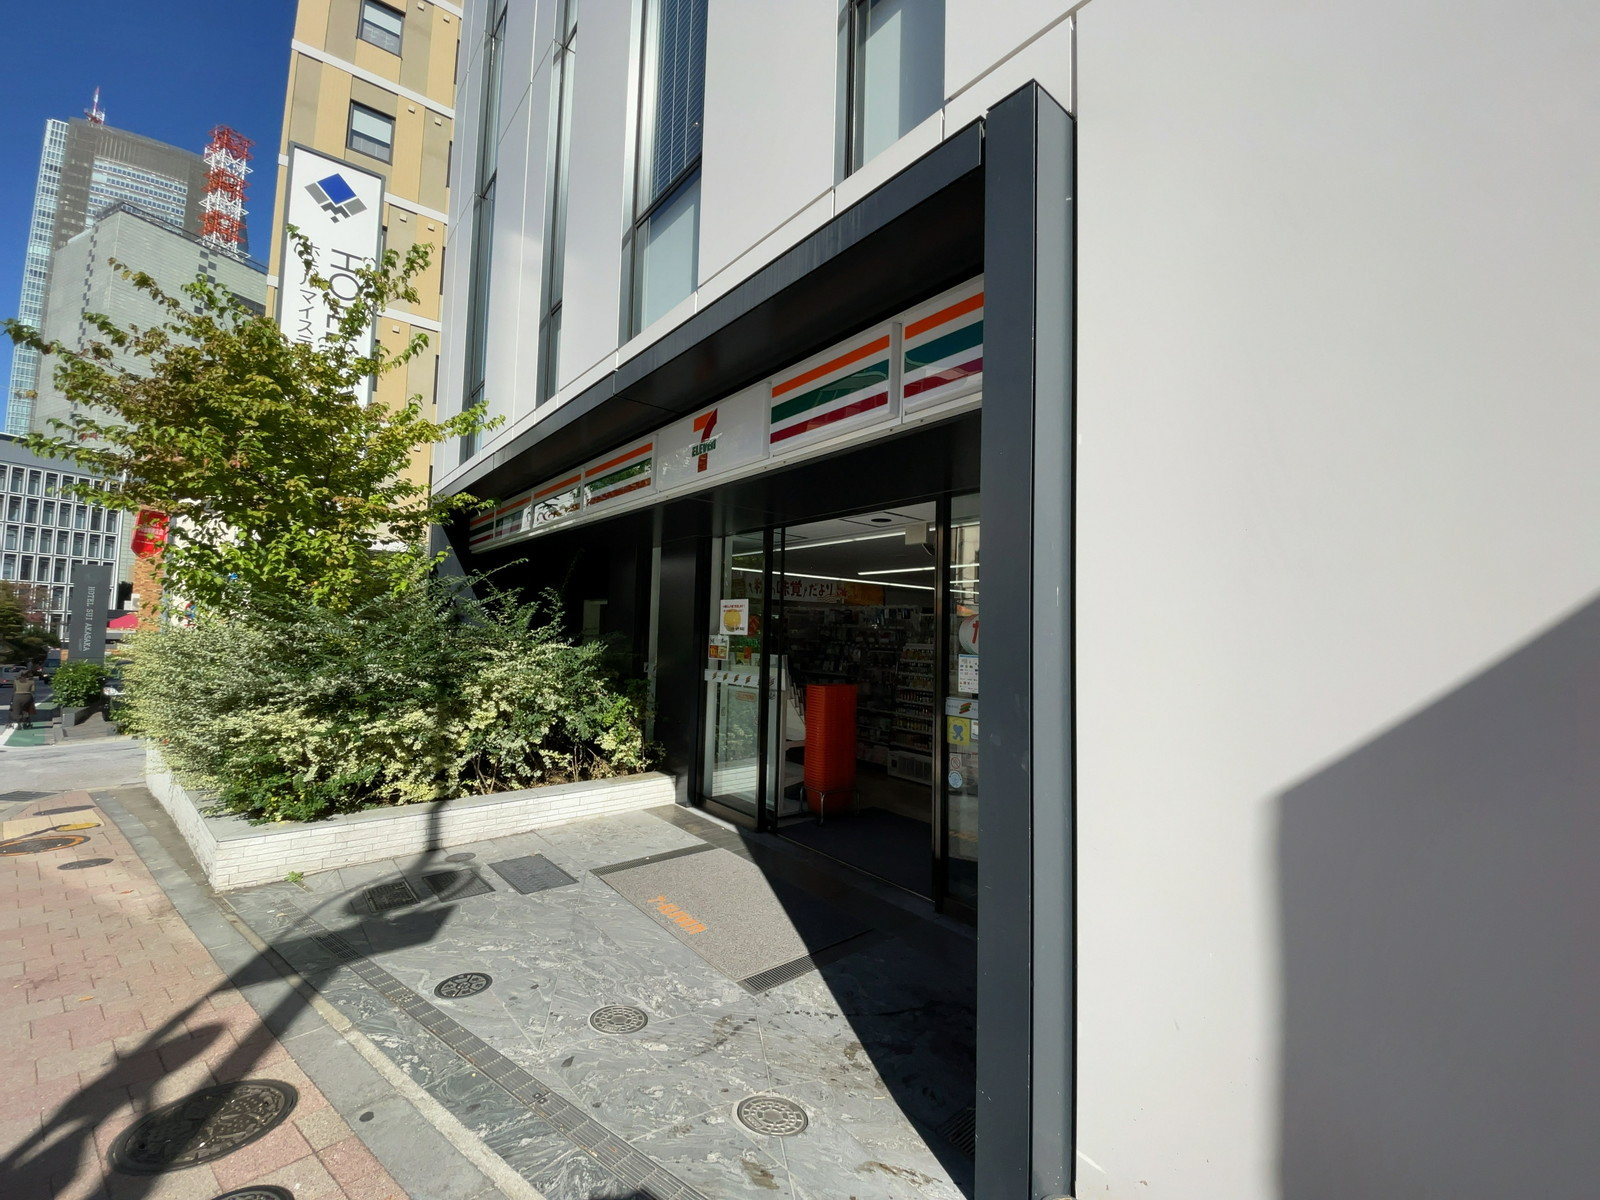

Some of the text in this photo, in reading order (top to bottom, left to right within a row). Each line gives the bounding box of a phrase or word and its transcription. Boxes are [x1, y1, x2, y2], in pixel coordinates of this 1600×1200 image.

[693, 408, 718, 473] 7
[82, 586, 96, 652] HOTEL SUI AKASAKA
